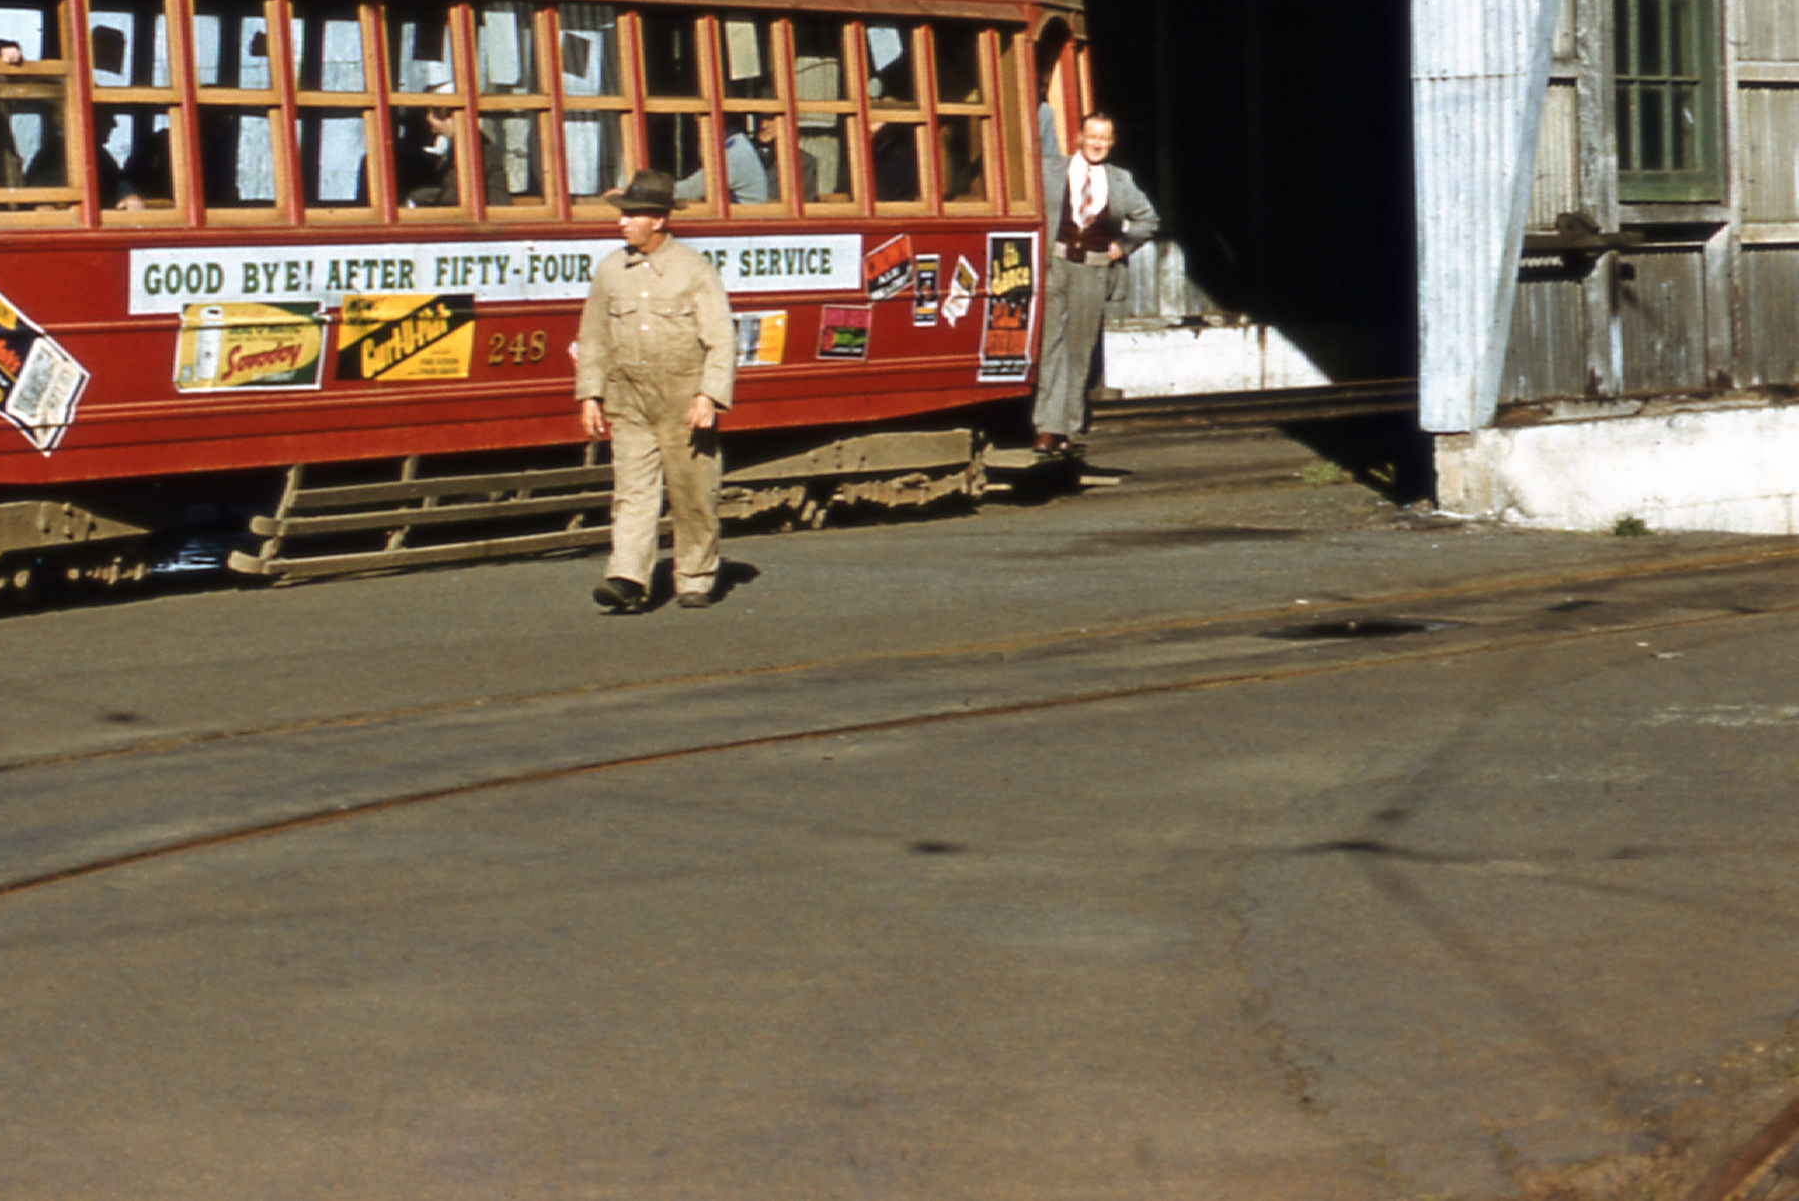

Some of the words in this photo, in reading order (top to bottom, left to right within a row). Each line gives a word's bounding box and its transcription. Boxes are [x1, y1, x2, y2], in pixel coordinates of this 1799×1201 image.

[143, 263, 224, 296] GOOD
[241, 260, 313, 294] BYE!
[326, 258, 415, 291] AFTER
[434, 253, 593, 287] FIFTY-FOUR
[739, 247, 832, 277] SERVICE
[488, 329, 548, 366] 248
